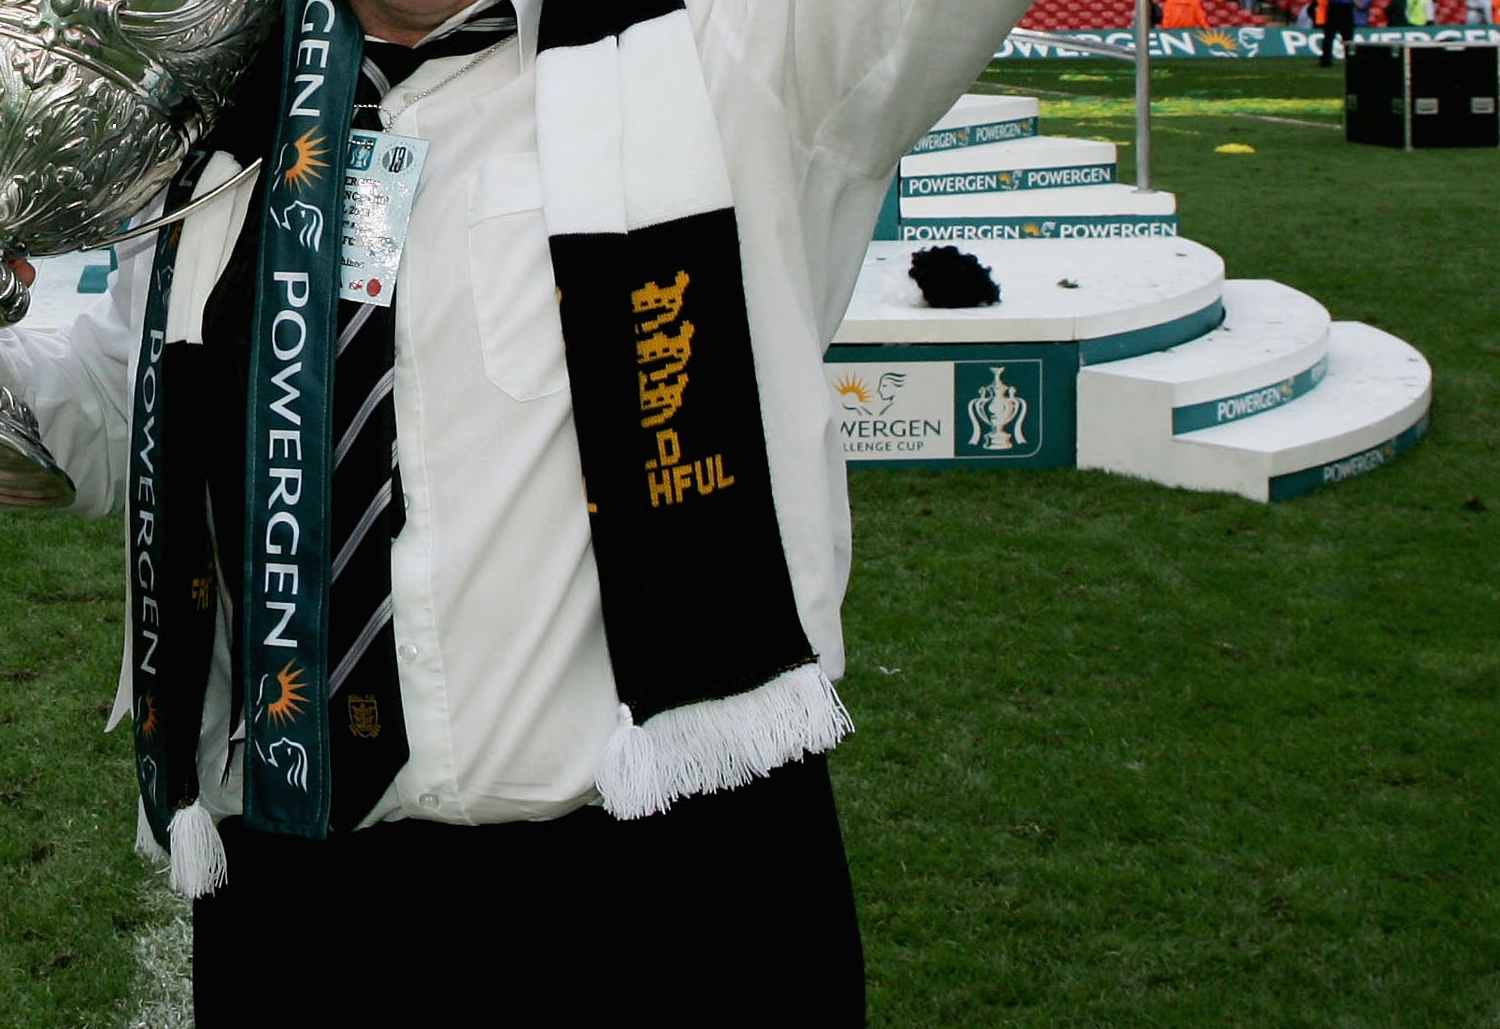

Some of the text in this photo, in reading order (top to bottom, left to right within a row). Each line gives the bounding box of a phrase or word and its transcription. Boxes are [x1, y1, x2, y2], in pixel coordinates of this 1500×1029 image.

[976, 123, 1022, 141] POWERGEN
[909, 168, 1111, 194] POWERGEN POWERGEN
[904, 222, 1178, 240] POWERGEN POWERGEN
[1217, 388, 1282, 422] POWERGEN
[262, 271, 310, 649] POWERGEN
[897, 441, 924, 452] CUP
[1323, 450, 1385, 483] POWERGEN
[137, 328, 164, 675] POWERGEN
